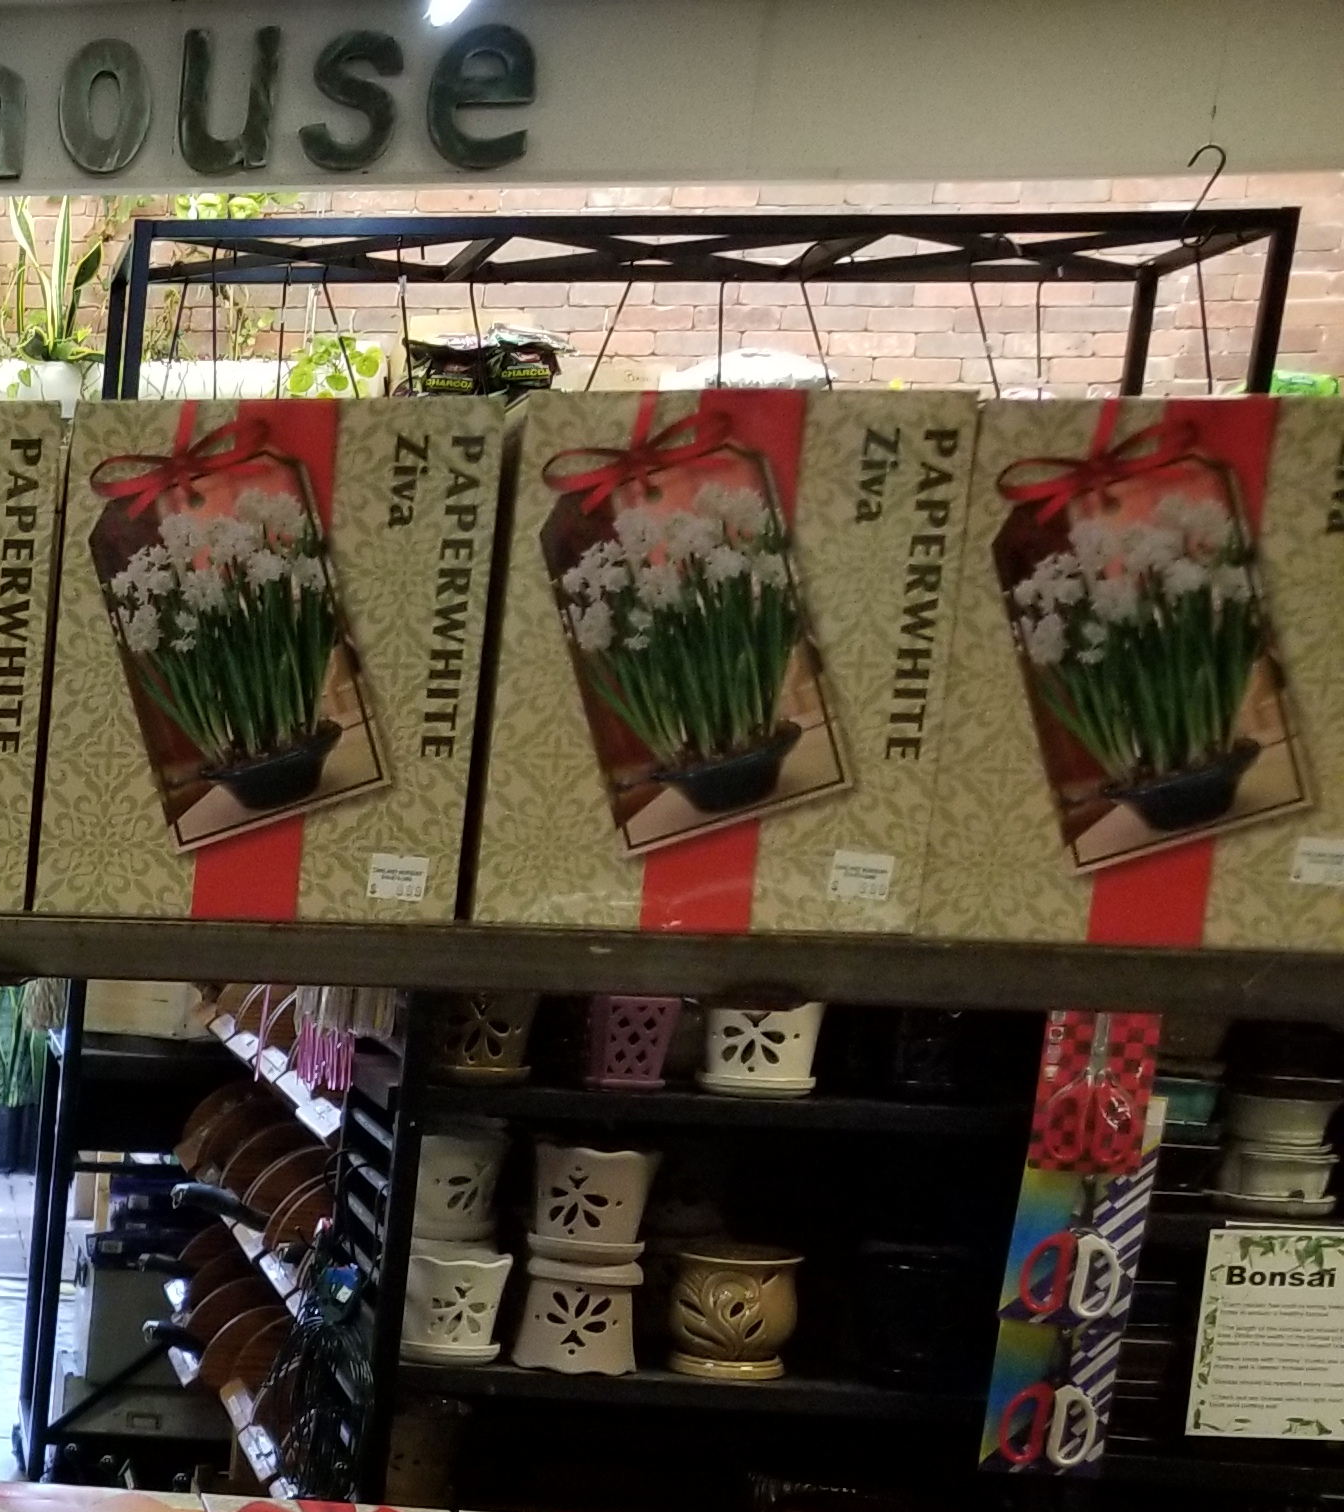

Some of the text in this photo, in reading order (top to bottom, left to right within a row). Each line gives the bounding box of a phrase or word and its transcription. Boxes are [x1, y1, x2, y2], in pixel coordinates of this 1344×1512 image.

[388, 435, 429, 530] Ziva
[855, 427, 900, 524] Ziva
[420, 435, 486, 760] PAPERWHITE
[884, 427, 958, 761] PAPERWHITE
[1225, 1265, 1337, 1288] Bonsai
